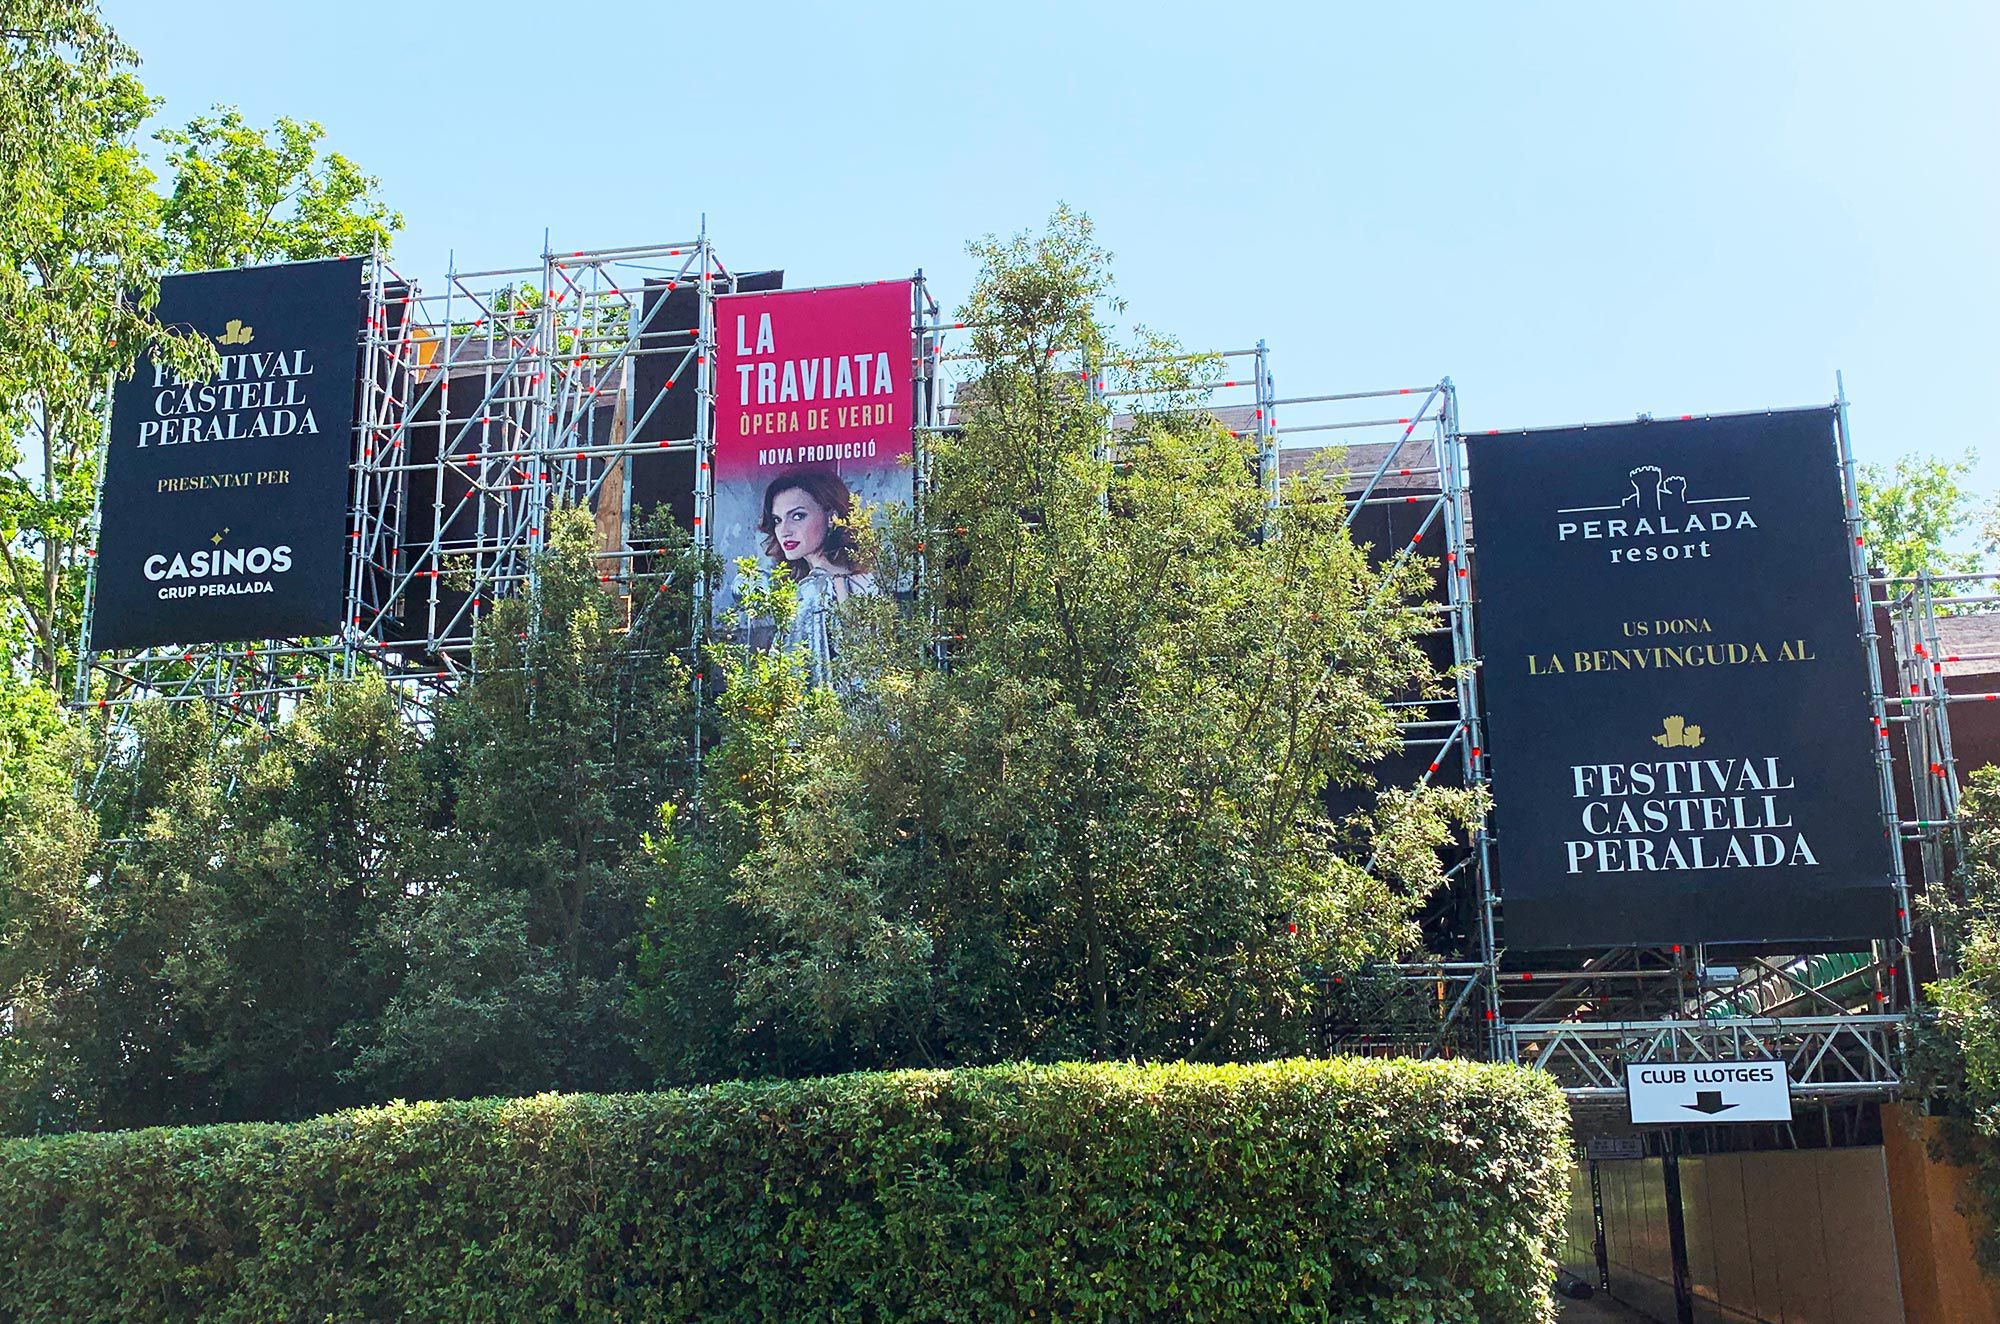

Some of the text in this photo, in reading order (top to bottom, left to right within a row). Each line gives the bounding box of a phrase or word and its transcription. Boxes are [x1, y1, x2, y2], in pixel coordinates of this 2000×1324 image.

[737, 313, 775, 356] LA
[152, 349, 314, 388] FTIVAL
[737, 353, 893, 406] TRAVIATA
[155, 379, 306, 417] CASTELL
[136, 407, 319, 448] PERALADA
[739, 402, 894, 436] ÒPERA DE VERDI
[759, 438, 876, 465] NOVA PRODUCCIÓ
[156, 470, 290, 493] PRESENTAT PER
[1558, 510, 1758, 541] PERALADA
[143, 545, 292, 582] CASINOS
[1610, 541, 1711, 563] resort
[158, 580, 274, 601] GRUP PERALADA
[1622, 618, 1712, 637] US DONA
[1527, 639, 1816, 676] LA BENVINGUDA AL
[1570, 757, 1796, 798] FESTIVAL
[1582, 795, 1793, 835] CASTELL
[1565, 833, 1820, 875] PERALADA
[1640, 1067, 1774, 1084] CLUB LLOTGES
